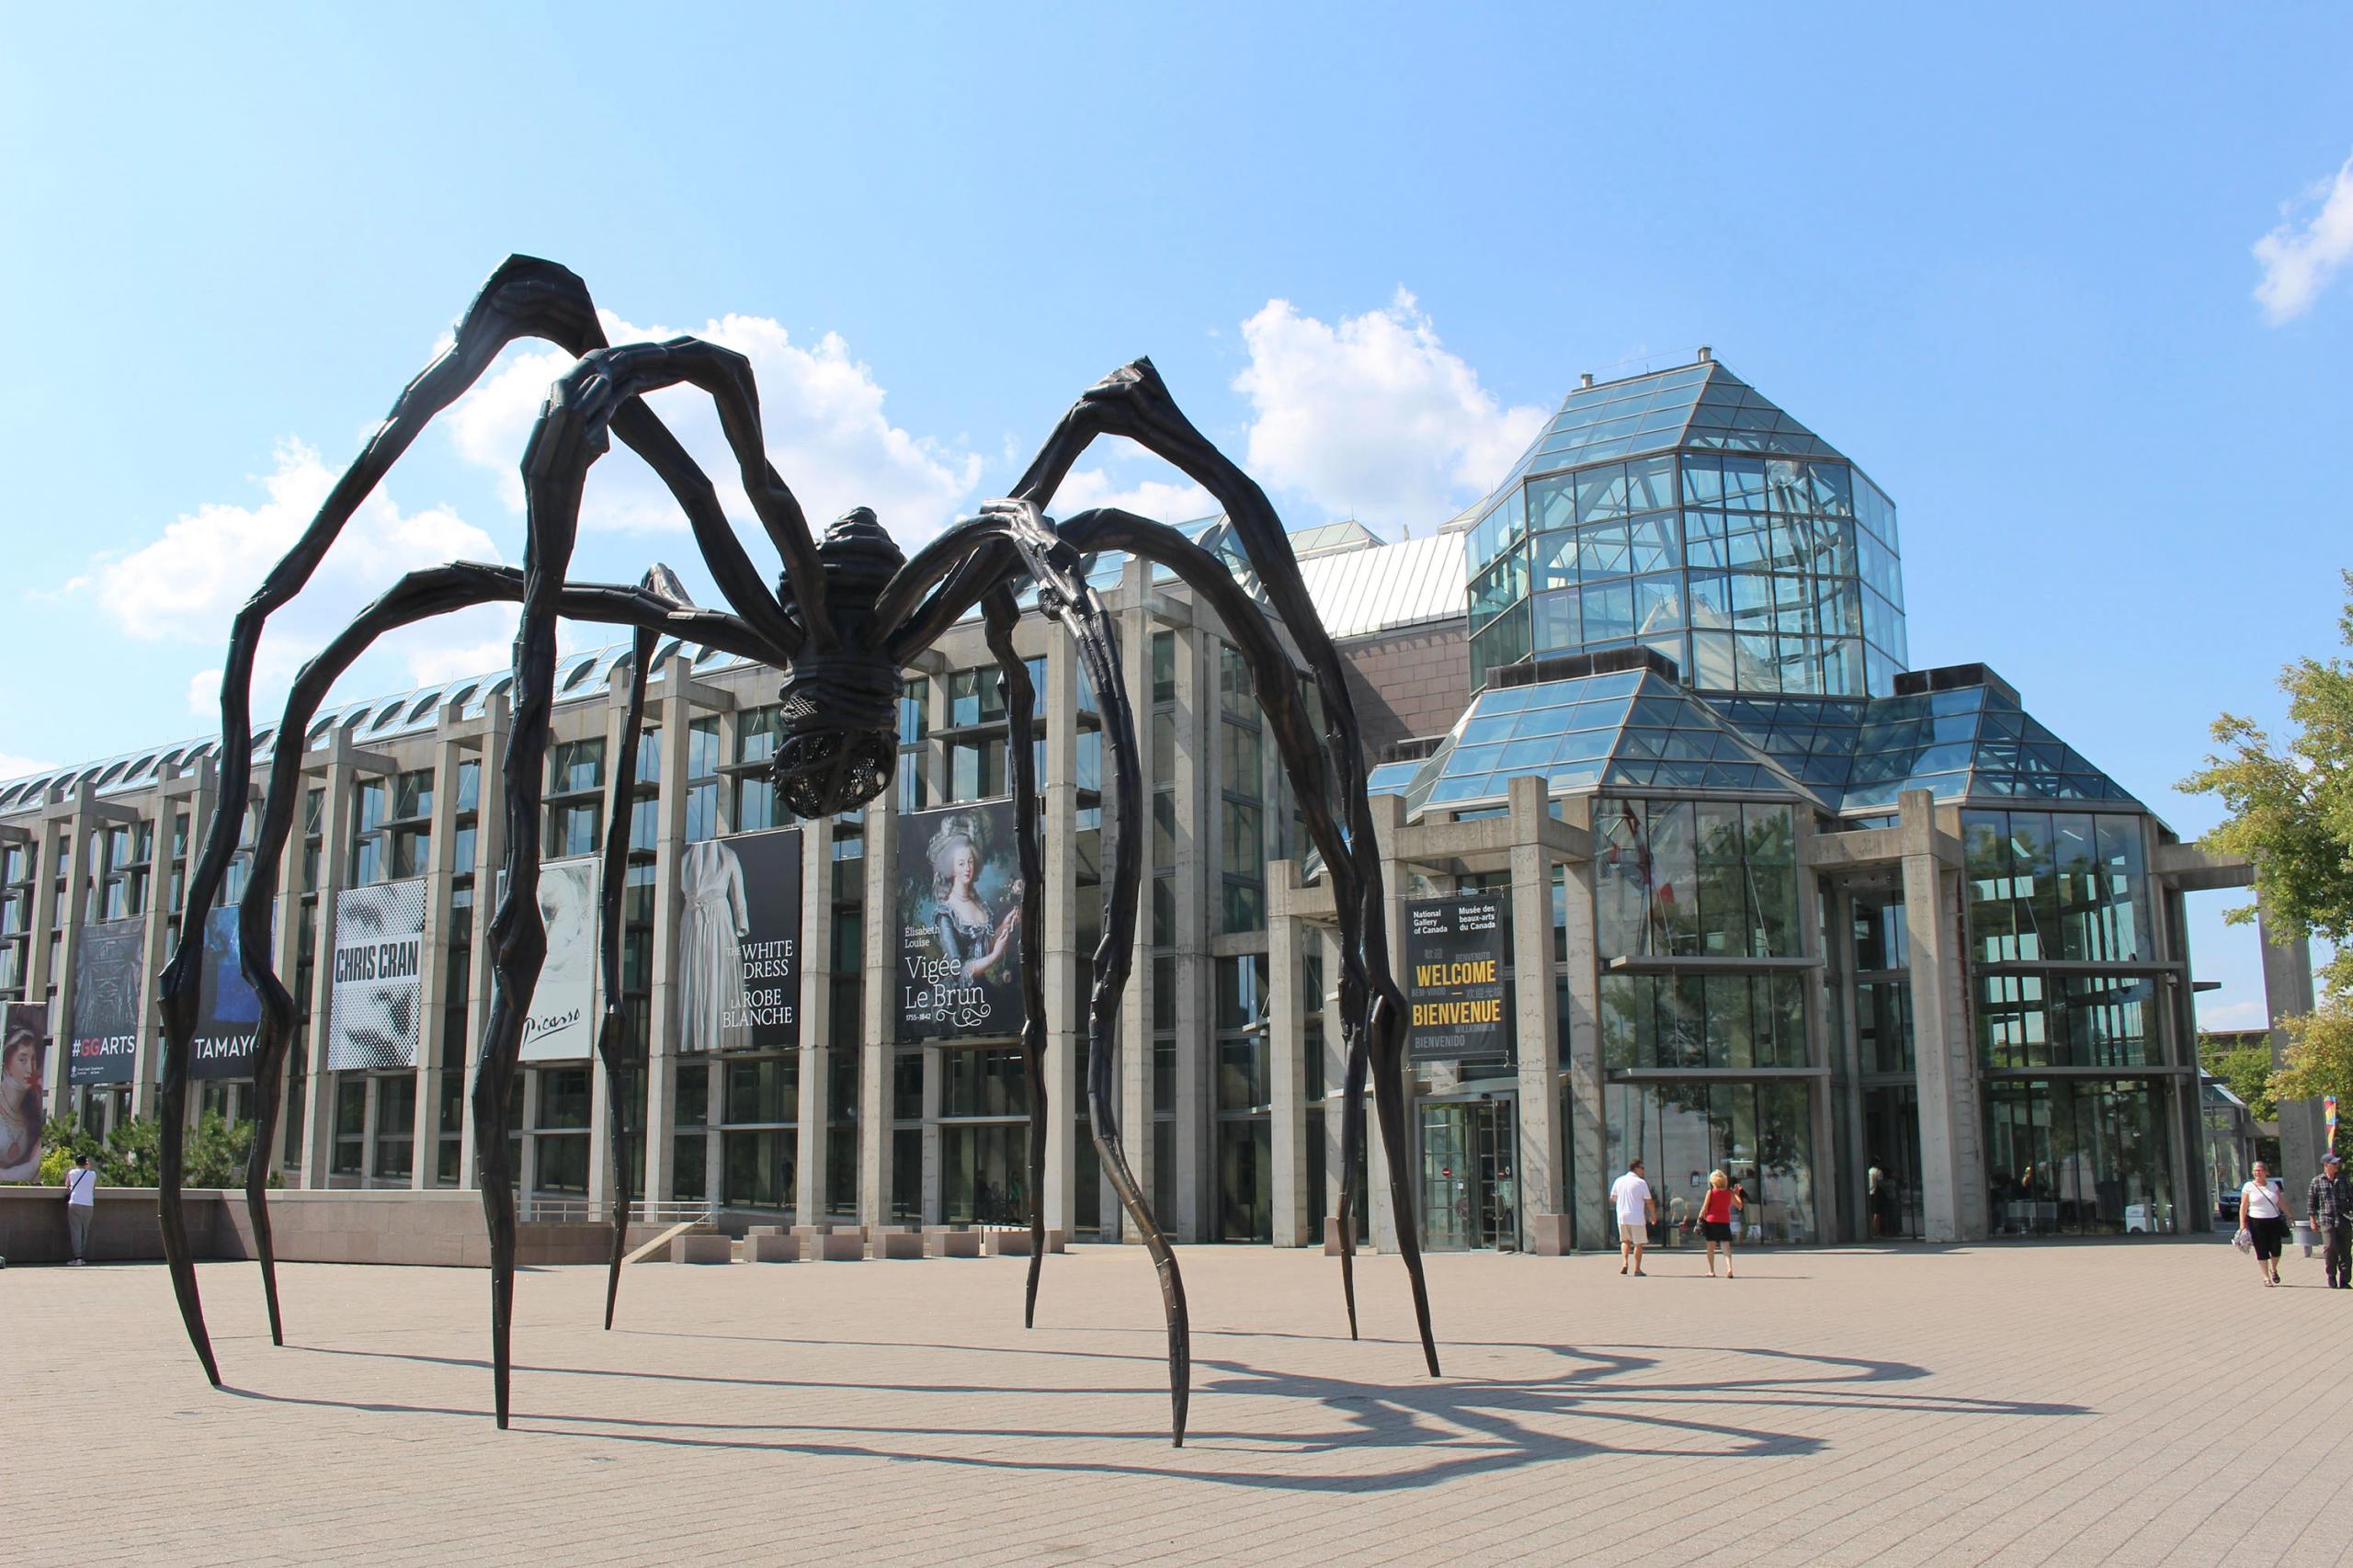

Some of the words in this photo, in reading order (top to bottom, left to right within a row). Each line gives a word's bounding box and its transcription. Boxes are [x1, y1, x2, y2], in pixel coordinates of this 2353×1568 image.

[1413, 909, 1441, 918] National
[1459, 905, 1481, 915] Musée
[1459, 914, 1495, 923] beaux-arts
[904, 925, 940, 937] Élisabeth
[1414, 918, 1438, 926] Gallery
[1422, 926, 1448, 934] Canada
[1471, 921, 1495, 930] Canada
[742, 940, 793, 960] WHITE
[904, 938, 930, 948] Louise
[335, 945, 376, 983] CHRIS
[379, 941, 418, 979] CRAN
[744, 960, 789, 979] DRESS
[904, 953, 961, 983] Vigée
[1416, 960, 1495, 987] WELCOME
[732, 1000, 741, 1009] LA
[744, 989, 781, 1007] ROBE
[905, 986, 927, 1008] Le
[933, 984, 984, 1006] Brun
[723, 1007, 792, 1028] BLANCHE
[1413, 1000, 1501, 1026] BIENVENUE
[523, 1008, 580, 1047] Picasso
[73, 1035, 135, 1057] #GGARTS
[1415, 1035, 1465, 1049] BIENVENIDO
